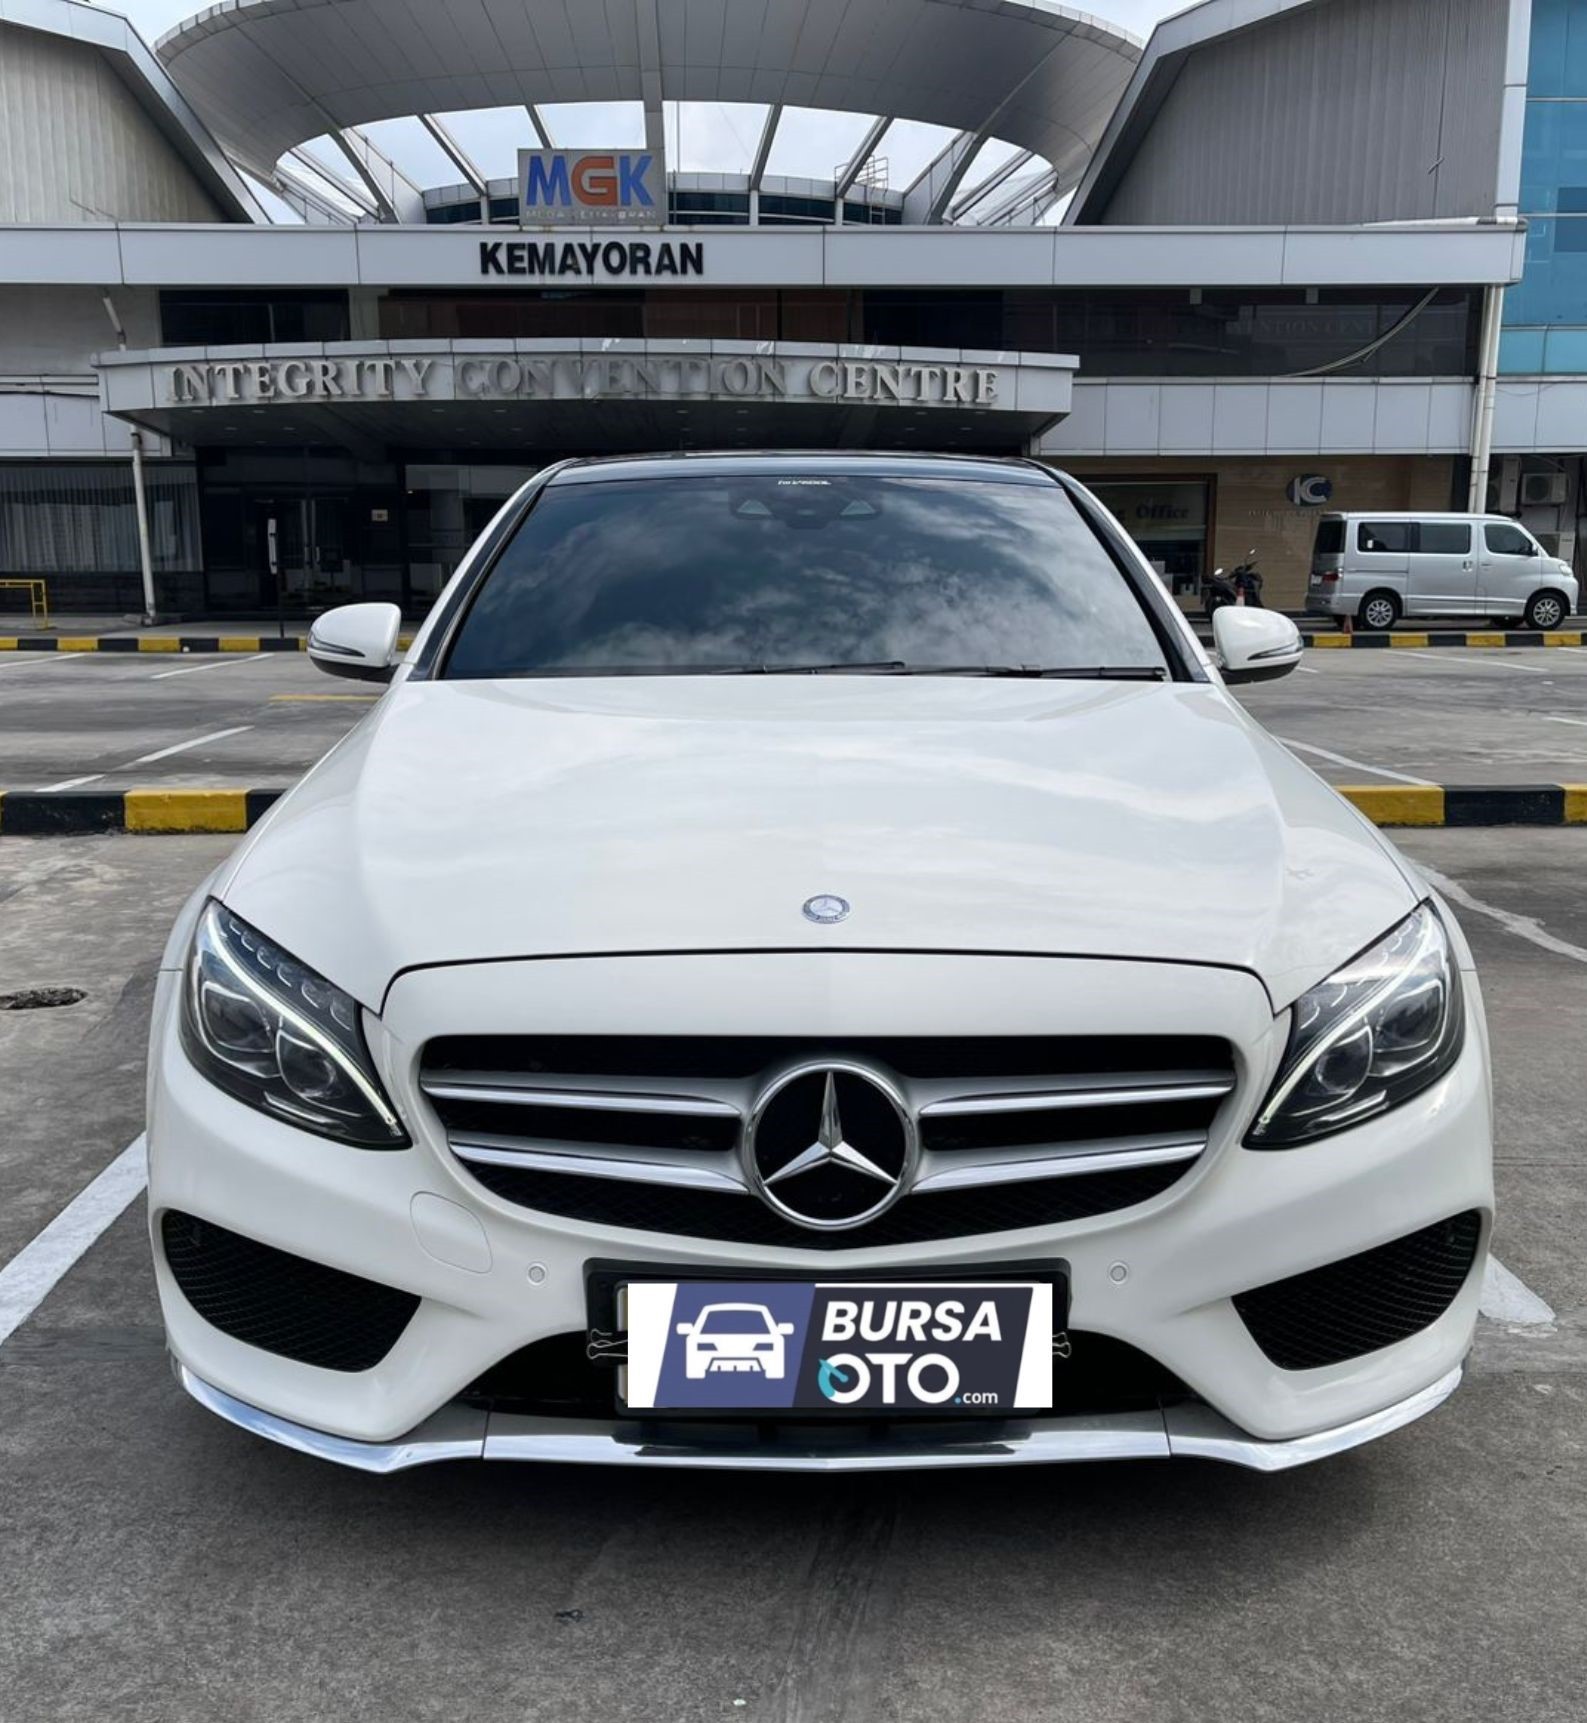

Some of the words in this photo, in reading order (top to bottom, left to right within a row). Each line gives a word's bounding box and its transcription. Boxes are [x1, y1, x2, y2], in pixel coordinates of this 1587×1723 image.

[526, 154, 655, 207] MGK
[480, 242, 704, 275] KEMAYORAN
[170, 358, 433, 400] INTEGRITY
[455, 357, 787, 396] CONVENTION
[810, 361, 999, 404] CENTRE
[1135, 503, 1190, 520] Office
